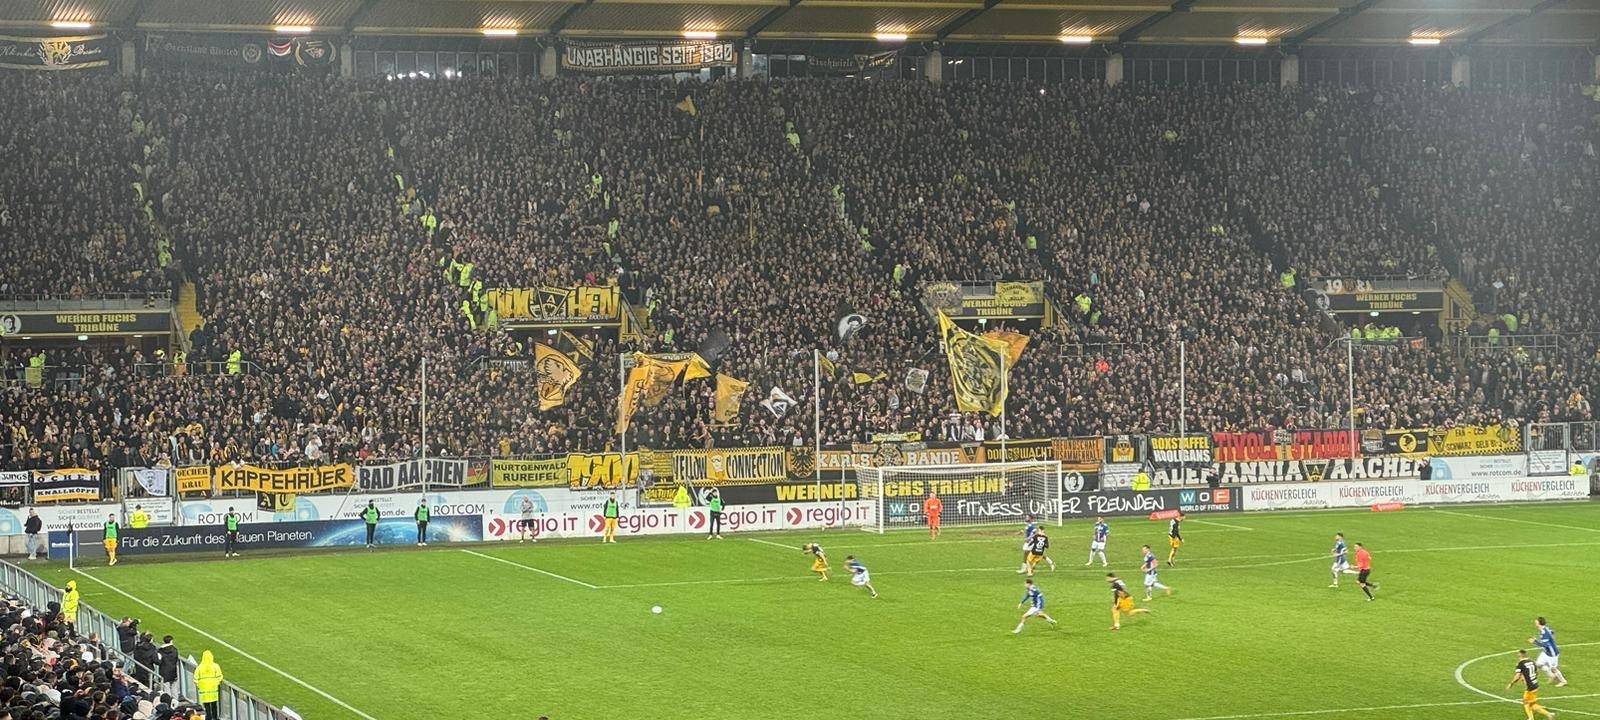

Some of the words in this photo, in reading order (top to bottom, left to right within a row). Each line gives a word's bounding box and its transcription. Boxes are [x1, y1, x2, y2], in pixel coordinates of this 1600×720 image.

[567, 45, 659, 67] UNABHÄNGIG
[662, 46, 696, 65] SEIT
[700, 43, 733, 63] 1900
[1355, 293, 1389, 301] WERNER
[1390, 293, 1417, 301] FUCHS
[975, 307, 1014, 316] TRIBÜNE
[1369, 301, 1405, 309] TRIBÜNE
[55, 314, 100, 323] WERNER
[102, 313, 137, 323] FUCHS
[73, 322, 120, 332] TRIBÜNE
[1151, 436, 1210, 450] BOXSTAFFEL
[818, 453, 871, 467] KARLS
[908, 451, 960, 466] BANDE
[1153, 449, 1211, 463] HOOLIGANS
[673, 452, 707, 481] YELLOW
[726, 451, 784, 479] CONNECTION
[1471, 469, 1522, 477] www.rotcom.de
[359, 466, 394, 490] BAD
[397, 459, 465, 486] AACHEN
[503, 472, 560, 482] RUREIFEL
[37, 487, 97, 496] KNALLKÖPPE
[776, 483, 858, 501] WERNER
[861, 479, 925, 498] FUCHS
[1339, 485, 1404, 498] KÜCHENVERGLEICH
[1425, 482, 1490, 497] KÜCHENVERGLEICH
[1511, 479, 1576, 493] KÜCHENVERGLEICH
[1251, 486, 1317, 501] KÜCHENVERGLEICH
[433, 503, 485, 516] ROTCOM
[956, 499, 1023, 516] FITNESS
[1029, 497, 1082, 515] UNTER
[1087, 493, 1165, 512] FREUNDEN
[1180, 504, 1199, 512] WORLD
[1208, 503, 1230, 511] FITNESS
[197, 511, 254, 525] ROTOM
[719, 506, 758, 530] egio
[806, 502, 851, 526] regio
[616, 510, 659, 533] egio
[122, 536, 144, 548] Für
[144, 535, 160, 547] die
[162, 533, 202, 547] Zukunft
[204, 533, 226, 545] des
[230, 531, 265, 544] lauen
[267, 530, 316, 542] Planeten.
